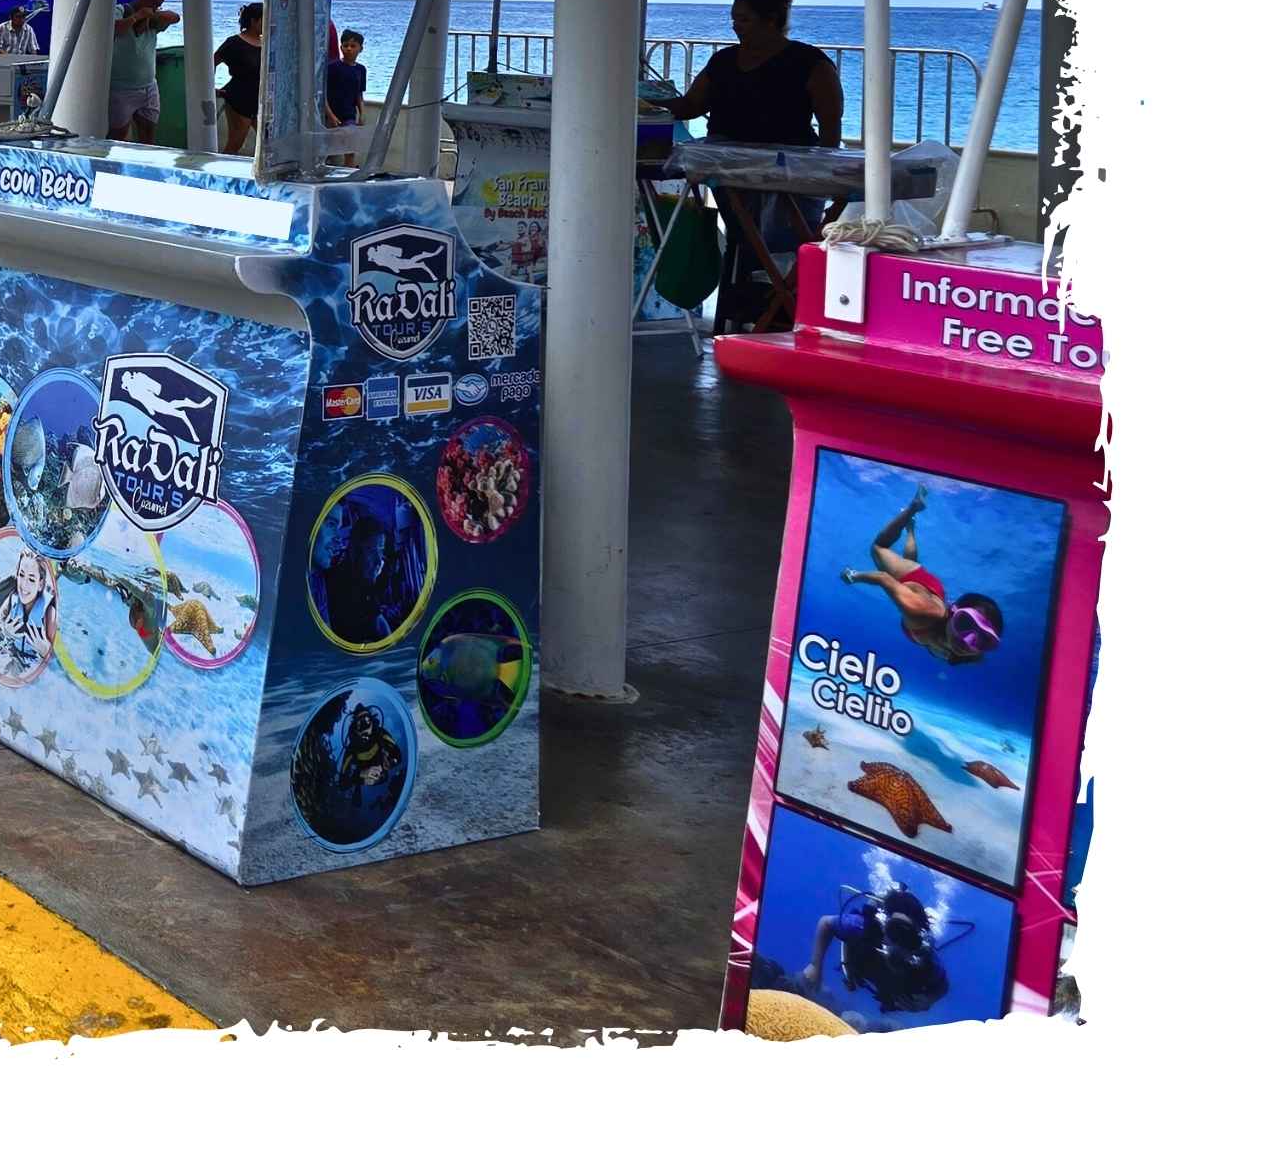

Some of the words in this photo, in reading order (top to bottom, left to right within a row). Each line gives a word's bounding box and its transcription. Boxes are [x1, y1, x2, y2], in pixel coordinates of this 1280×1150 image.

[0, 168, 35, 196] con
[40, 167, 89, 204] Beto
[494, 177, 515, 192] San
[497, 192, 539, 208] Beach
[942, 318, 1033, 359] Free
[1048, 333, 1110, 369] To
[491, 368, 542, 387] mercado
[414, 387, 443, 401] VISA
[501, 386, 531, 402] pago
[114, 471, 184, 509] TOUR'S
[133, 486, 168, 517] Cozumel
[797, 633, 902, 697] Cielo
[811, 677, 914, 736] Cielito
